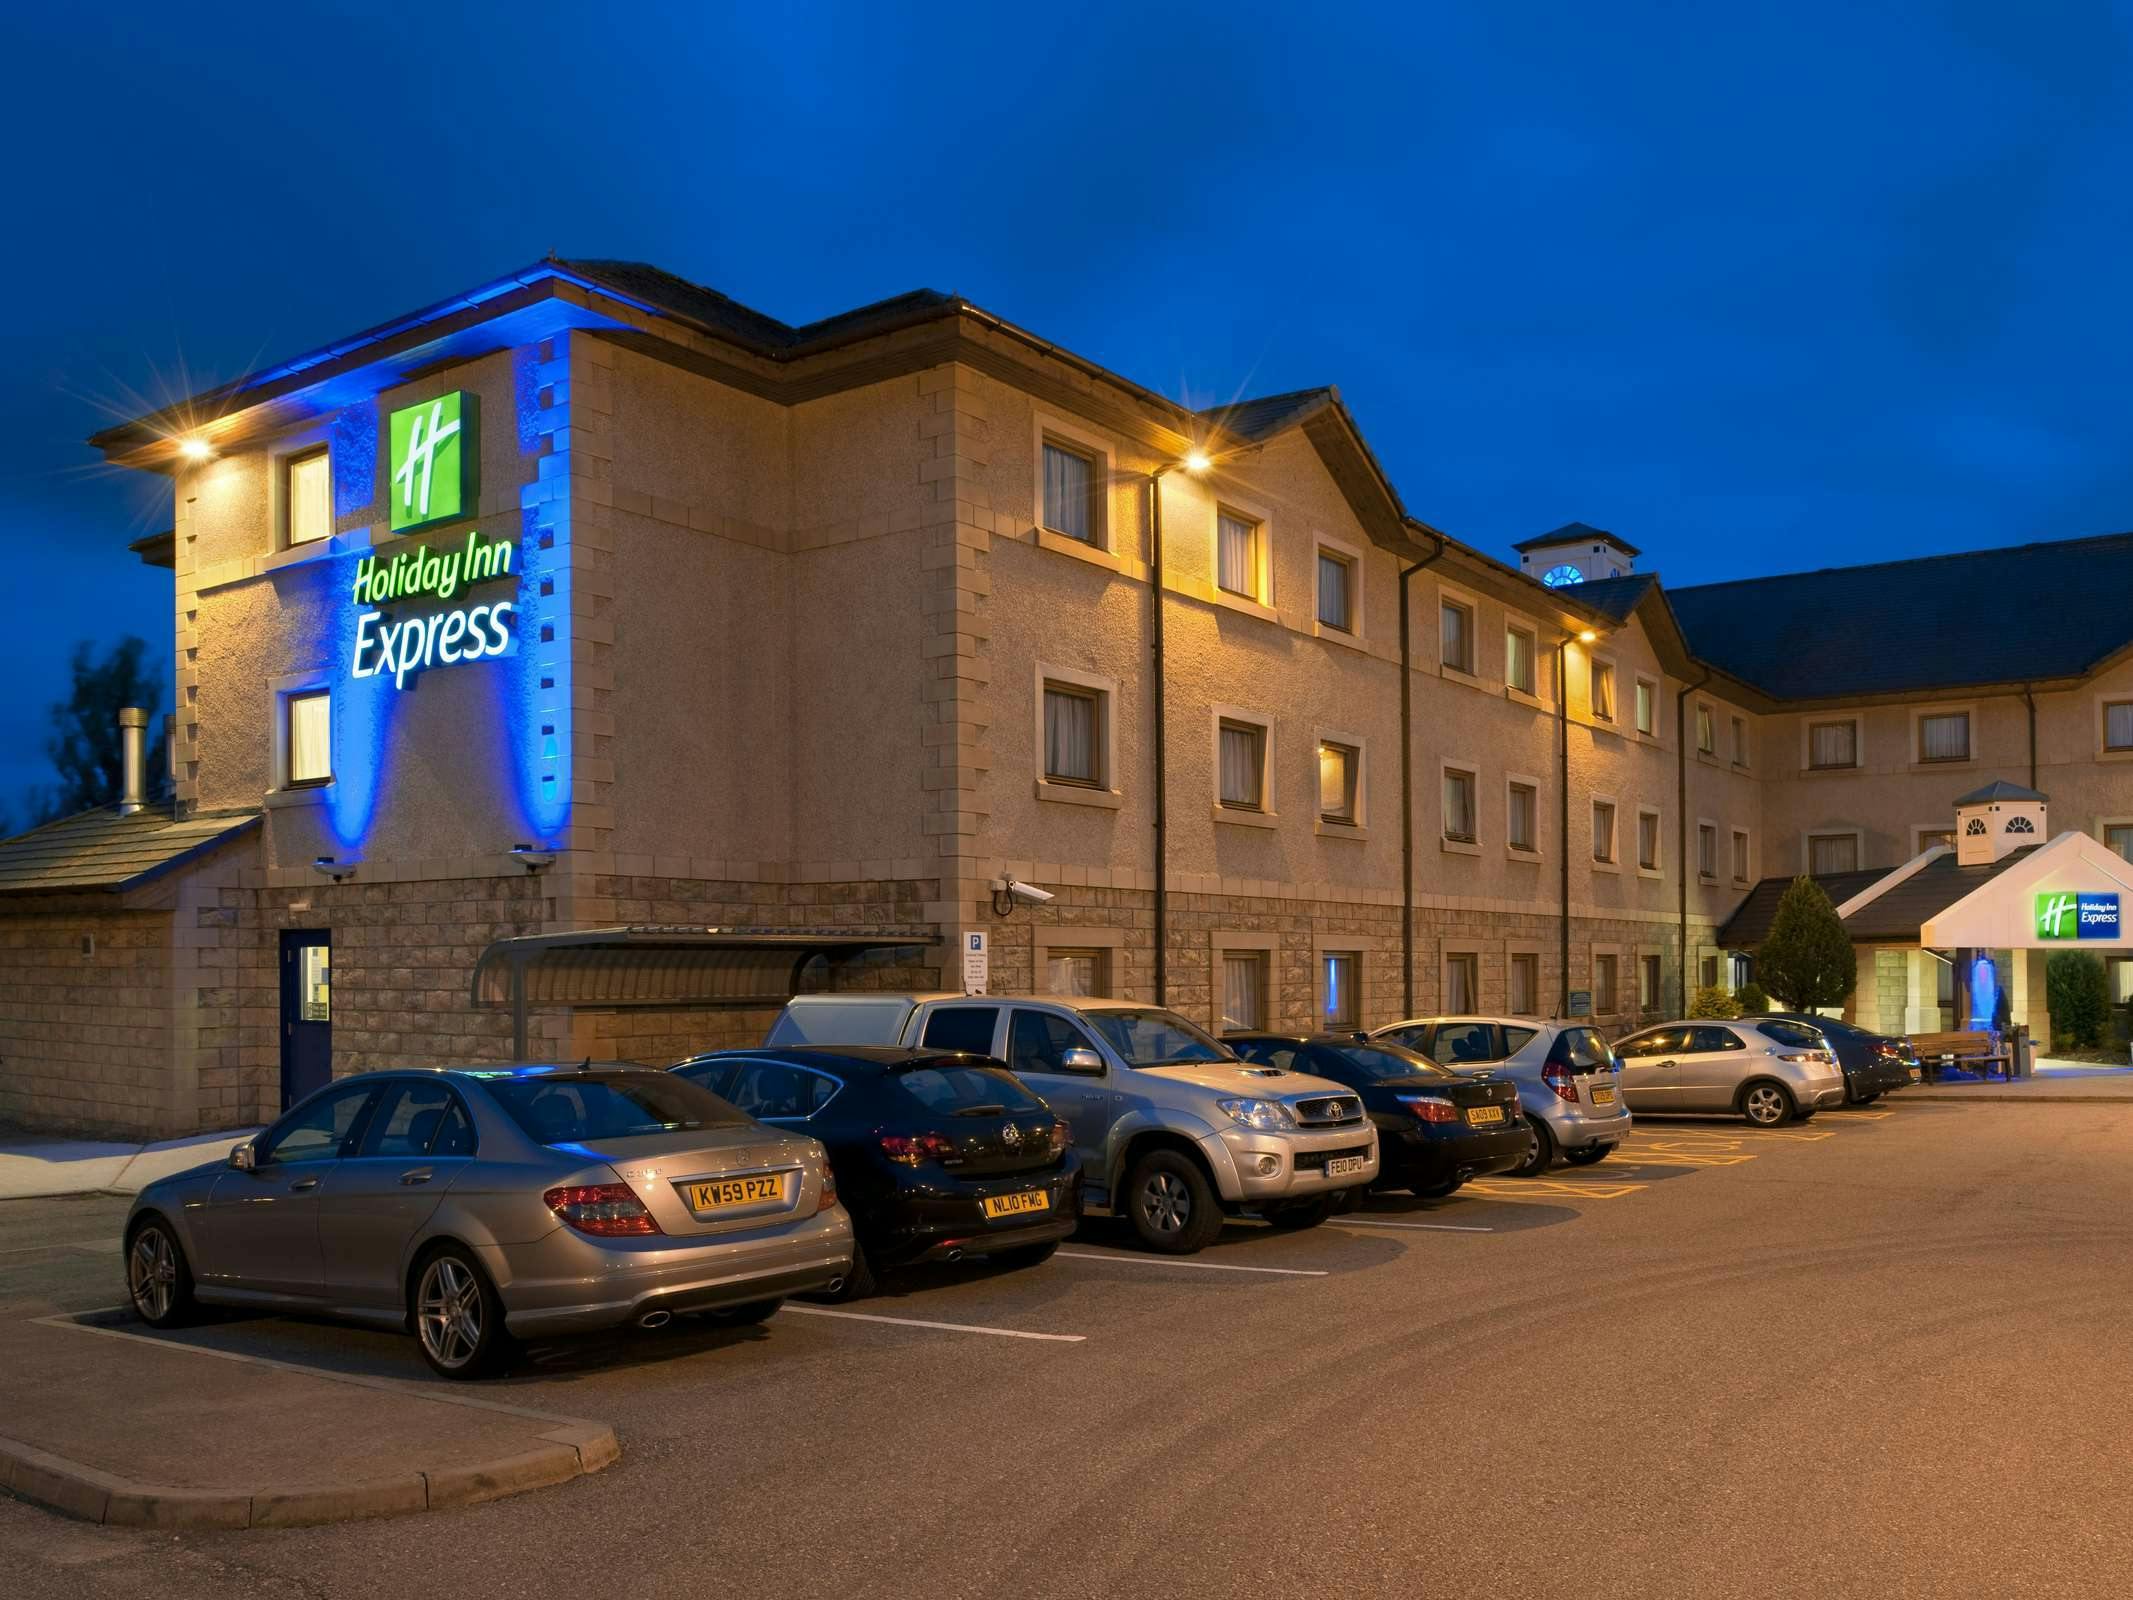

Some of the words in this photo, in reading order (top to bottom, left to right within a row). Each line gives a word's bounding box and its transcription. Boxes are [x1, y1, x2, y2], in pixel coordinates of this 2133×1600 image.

[352, 545, 460, 604] Holiday
[463, 531, 513, 581] Inn
[352, 600, 513, 690] Express
[2081, 902, 2106, 912] Holiday
[2106, 903, 2117, 911] Inn
[2081, 912, 2117, 925] Express
[972, 936, 980, 949] P
[1331, 1160, 1347, 1174] FE10
[1348, 1157, 1362, 1171] DPU
[699, 1183, 743, 1206] KW59
[746, 1179, 778, 1199] PZZ
[993, 1196, 1019, 1213] NL10
[1021, 1192, 1042, 1209] FMG
